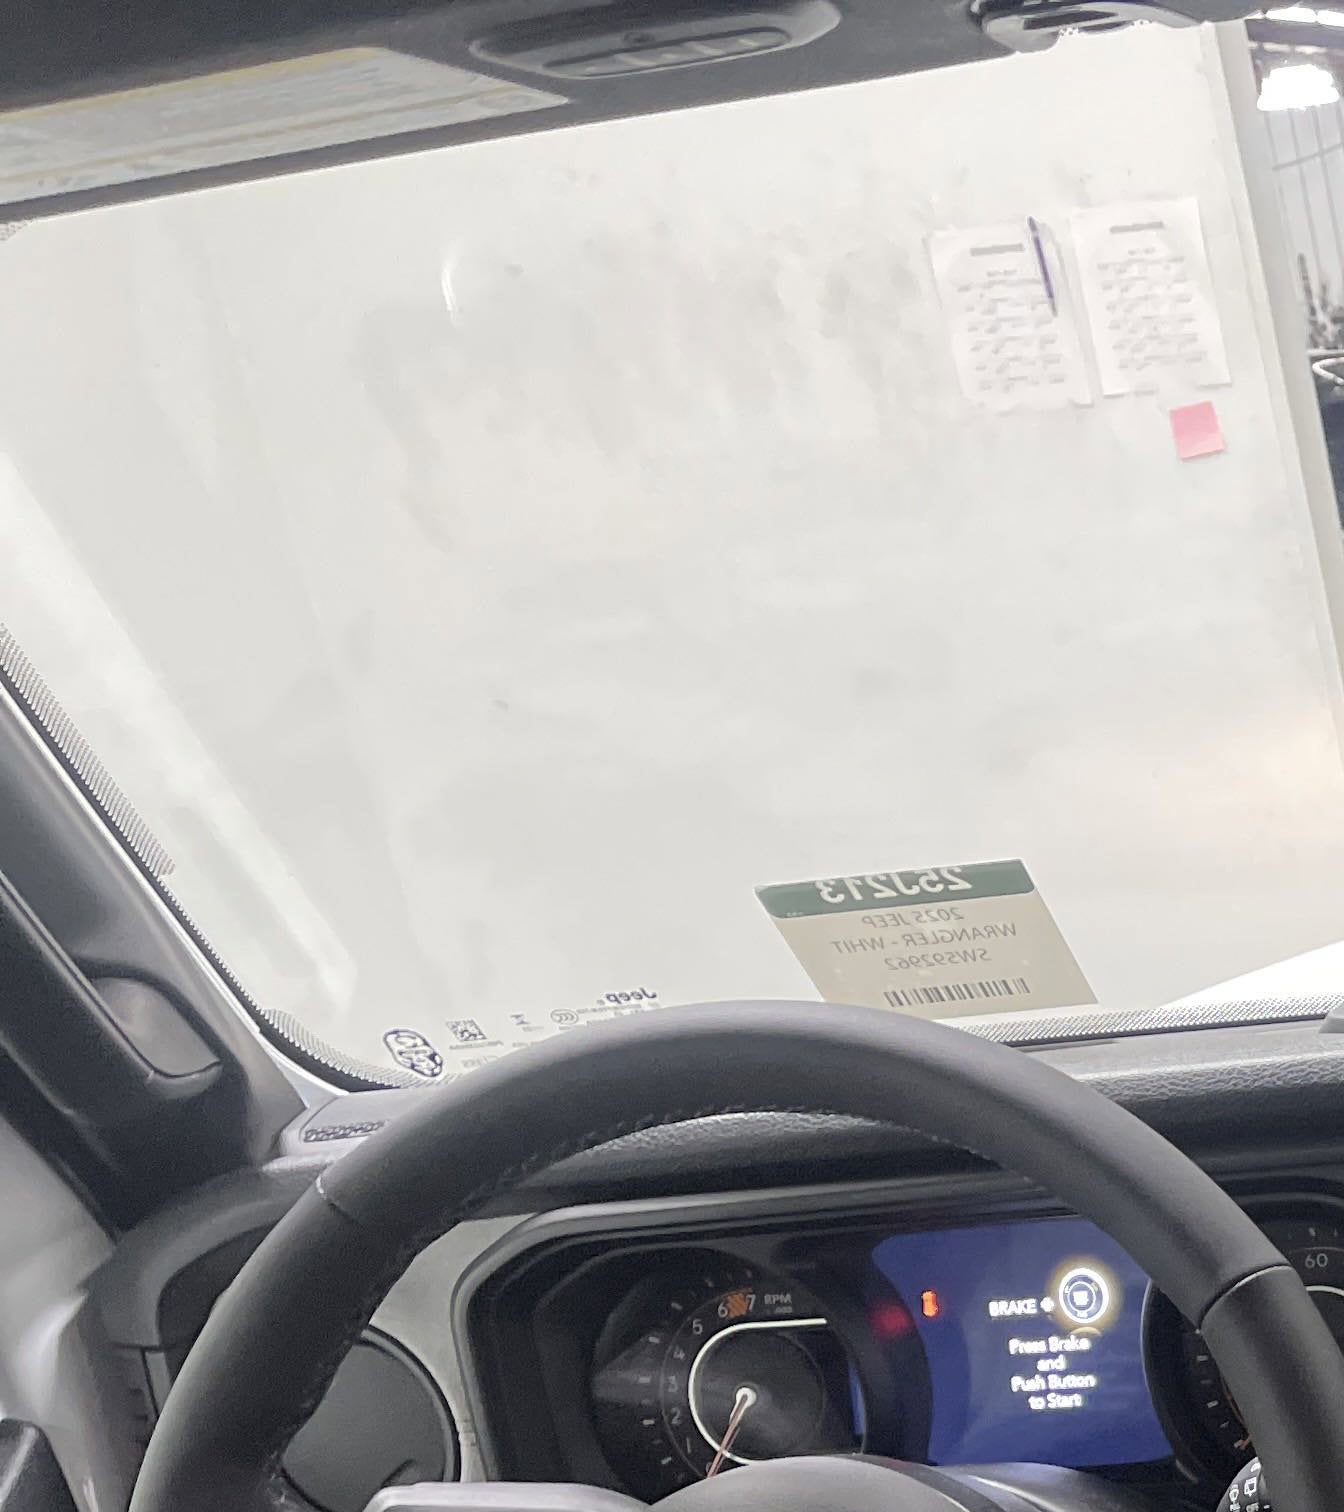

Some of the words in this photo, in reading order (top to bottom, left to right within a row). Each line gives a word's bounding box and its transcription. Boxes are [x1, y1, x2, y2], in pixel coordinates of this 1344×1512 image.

[1304, 1252, 1329, 1269] 60
[746, 1294, 756, 1311] 7
[764, 1293, 792, 1305] RPM
[989, 1298, 1038, 1317] BRAKE
[717, 1304, 729, 1318] 6
[692, 1318, 703, 1335] 5
[1008, 1337, 1046, 1355] Press
[1048, 1334, 1091, 1353] Brake
[1036, 1354, 1066, 1372] and
[1010, 1373, 1046, 1393] Push
[1047, 1373, 1097, 1391] Button
[1028, 1395, 1046, 1410] to
[1046, 1391, 1083, 1409] Start
